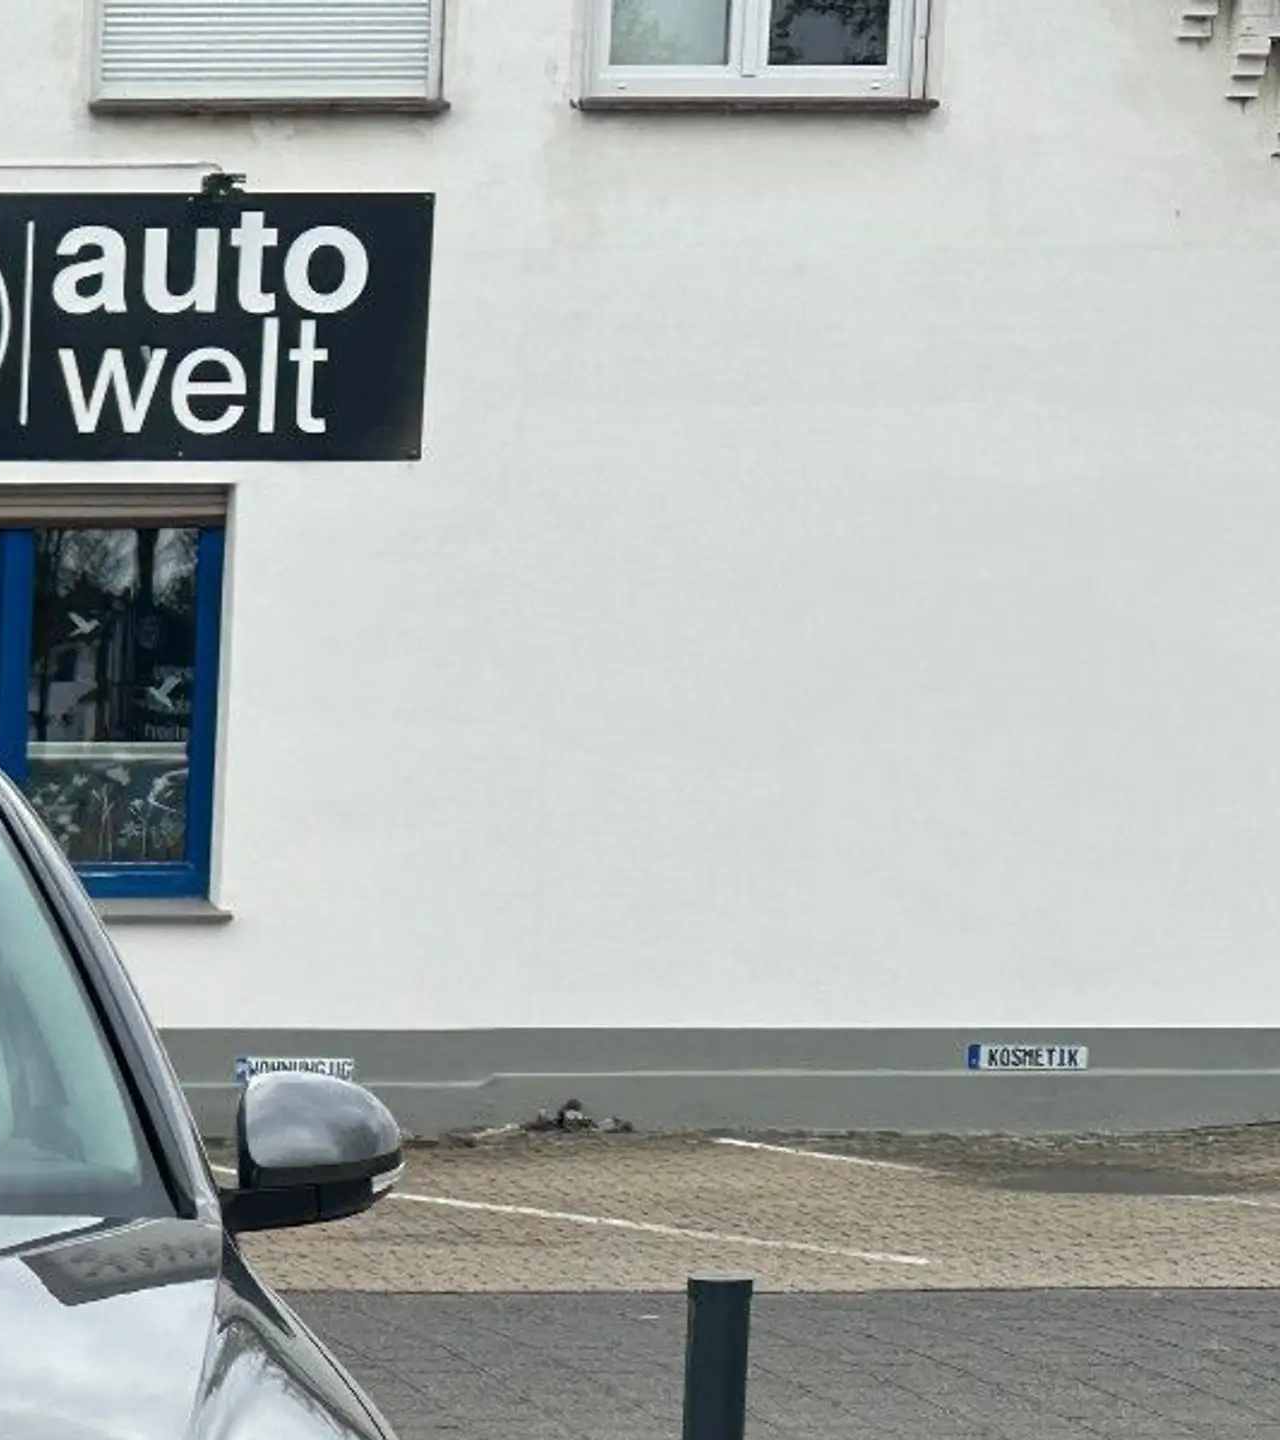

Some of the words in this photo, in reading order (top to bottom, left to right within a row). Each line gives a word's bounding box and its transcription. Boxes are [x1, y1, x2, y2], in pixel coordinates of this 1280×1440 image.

[51, 210, 369, 315] auto
[57, 316, 328, 434] welt
[987, 1046, 1079, 1067] KOSMETIK
